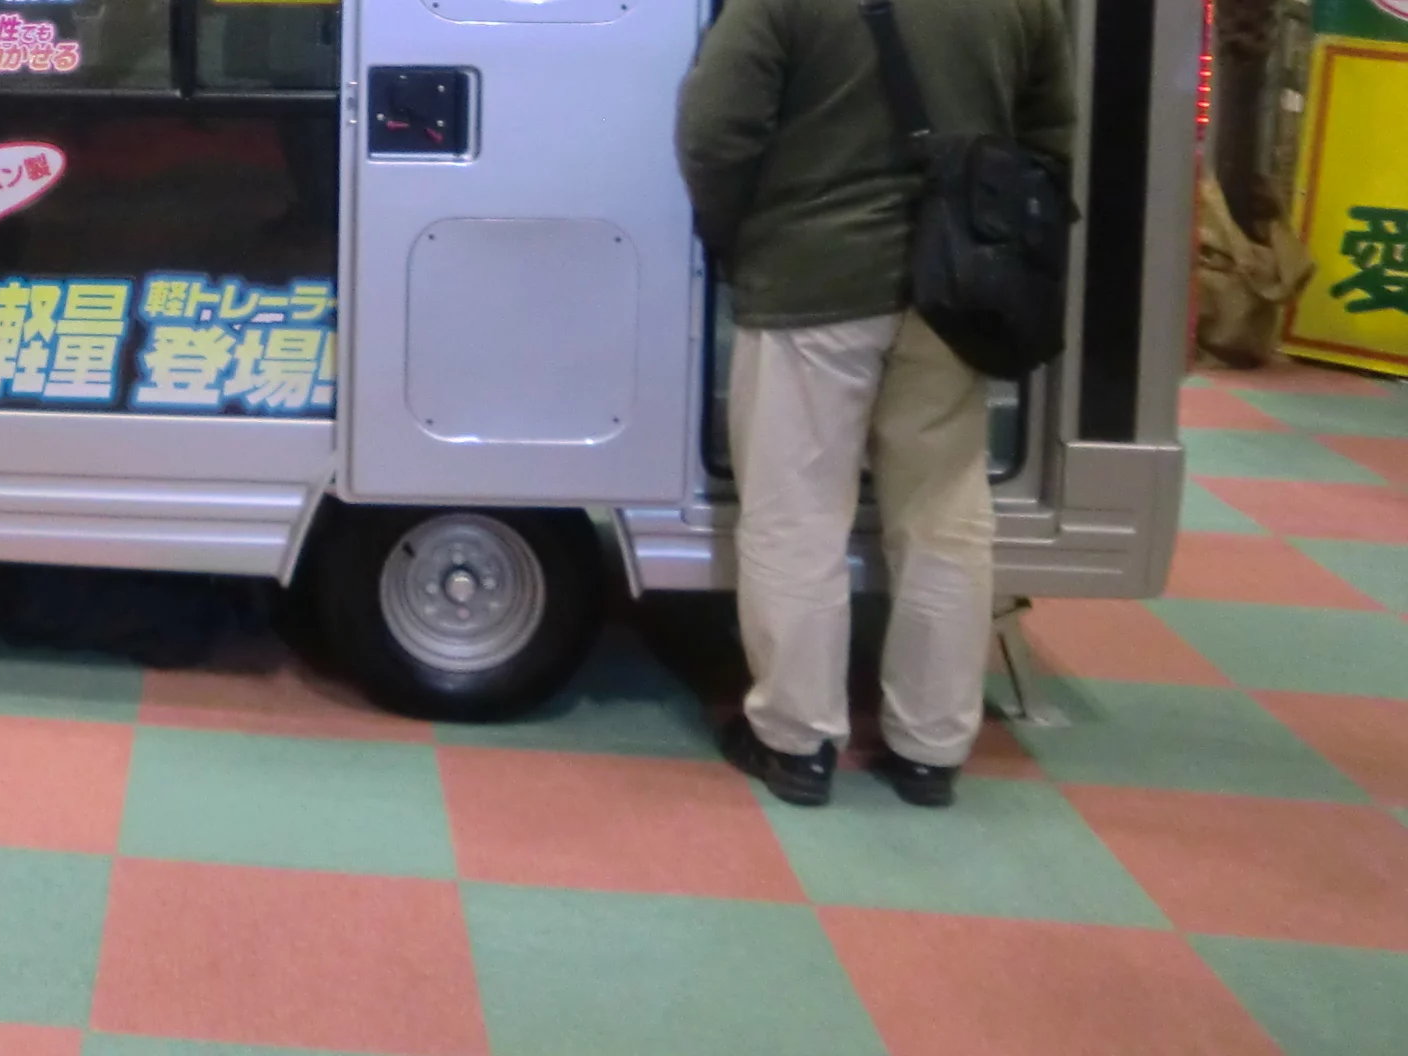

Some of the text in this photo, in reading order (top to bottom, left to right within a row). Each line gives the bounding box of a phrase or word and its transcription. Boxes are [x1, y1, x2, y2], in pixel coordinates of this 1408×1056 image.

[143, 280, 336, 320] 軽トレーラ
